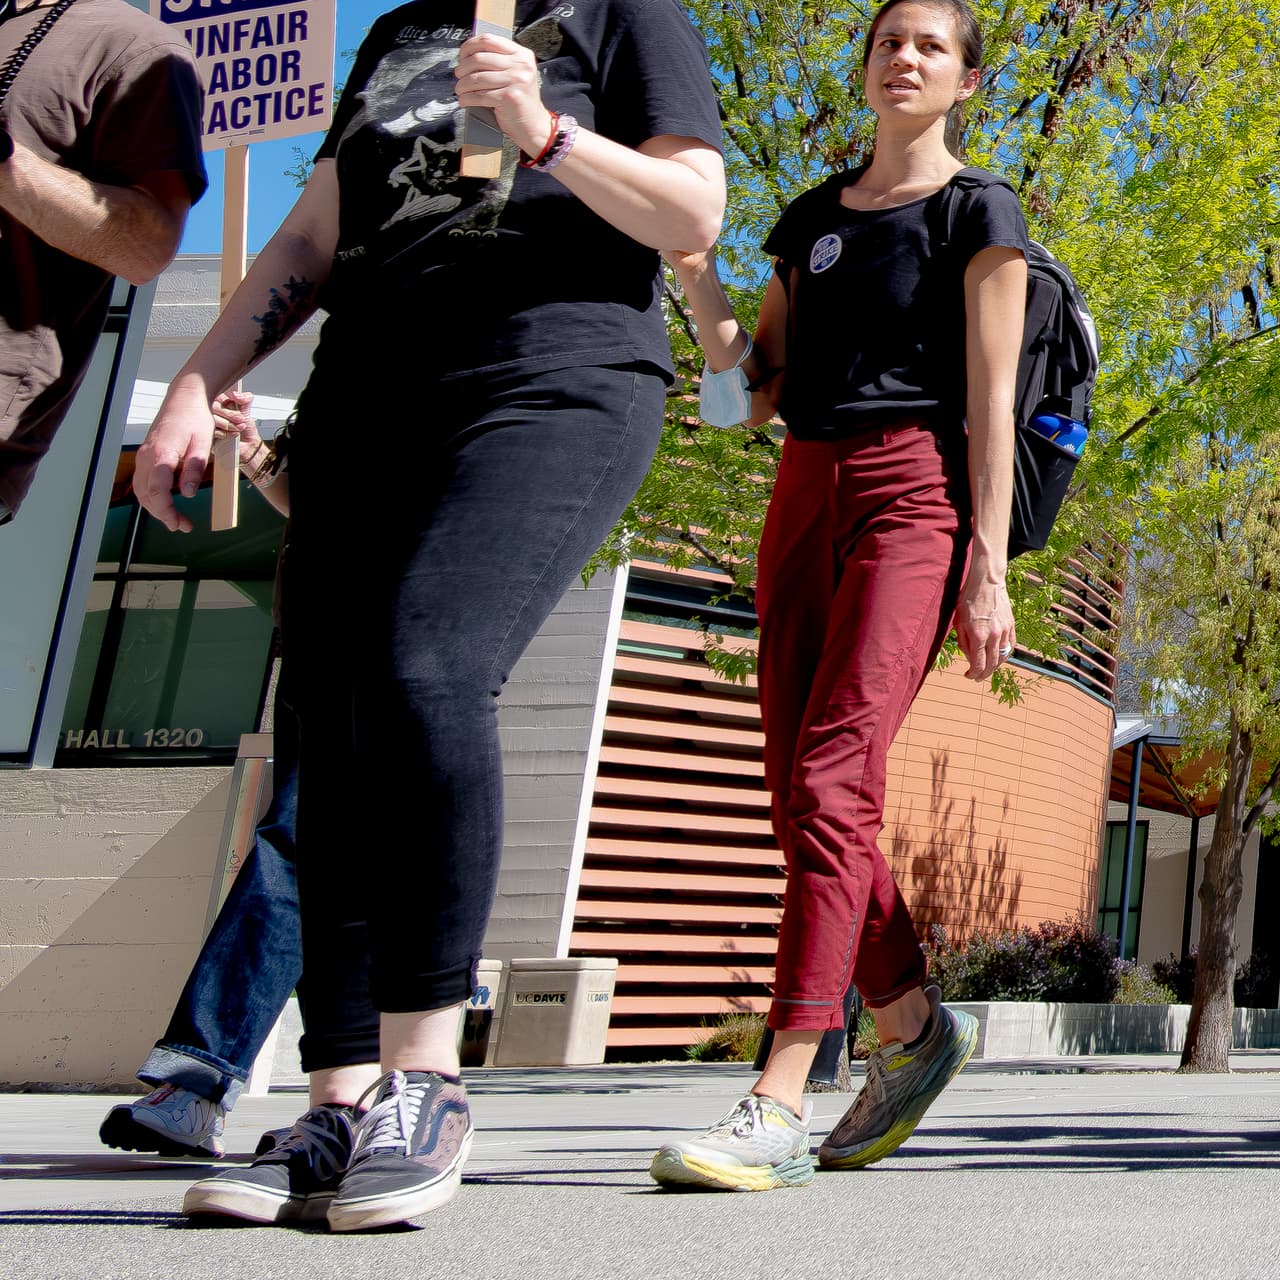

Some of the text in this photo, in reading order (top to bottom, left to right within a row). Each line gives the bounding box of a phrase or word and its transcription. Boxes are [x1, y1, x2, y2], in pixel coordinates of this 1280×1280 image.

[185, 9, 308, 60] UNFAIR
[207, 49, 301, 96] ABOR
[200, 82, 325, 136] ACTICE
[65, 728, 204, 749] HALL 1320
